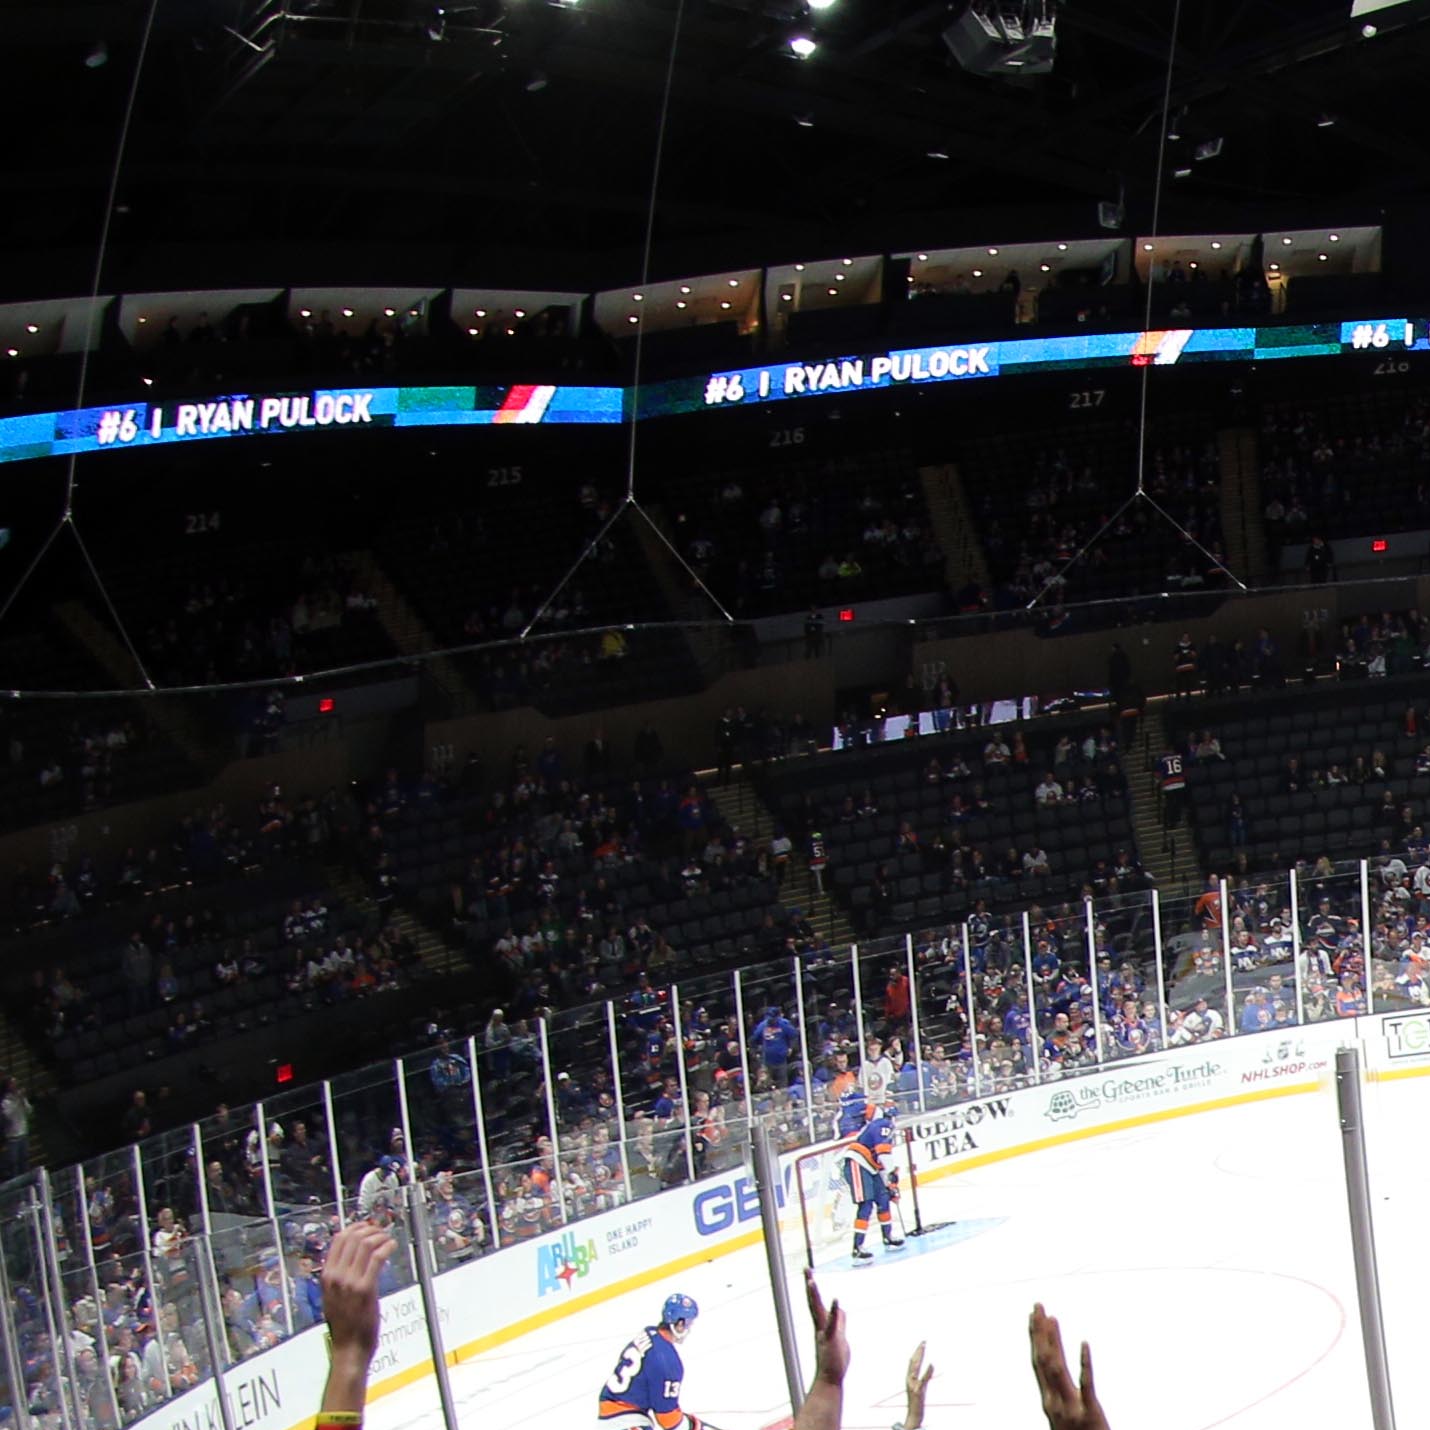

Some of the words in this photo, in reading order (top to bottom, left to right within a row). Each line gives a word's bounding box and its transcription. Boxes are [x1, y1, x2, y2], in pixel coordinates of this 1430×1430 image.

[1352, 322, 1390, 349] #6
[704, 374, 745, 405] #6
[784, 360, 863, 395] RYAN
[871, 347, 990, 384] PULOCK
[1069, 390, 1105, 409] 217
[97, 410, 136, 445] #6
[176, 400, 253, 437] RYAN
[260, 393, 372, 429] PULOCK
[770, 427, 805, 447] 216
[487, 465, 522, 487] 215
[185, 511, 220, 534] 214
[1165, 759, 1182, 774] 16
[1079, 1085, 1102, 1101] the
[1102, 1074, 1165, 1100] Greene
[1167, 1060, 1221, 1084] Turtle
[1240, 1059, 1328, 1084] NHLSHOP.COM
[924, 1131, 980, 1162] TEA
[606, 1229, 625, 1244] ONE
[625, 1219, 654, 1239] HAPPY
[608, 1237, 640, 1256] ISLAND
[537, 1230, 599, 1297] ARUBA
[392, 1298, 418, 1321] York
[664, 1380, 681, 1398] 13
